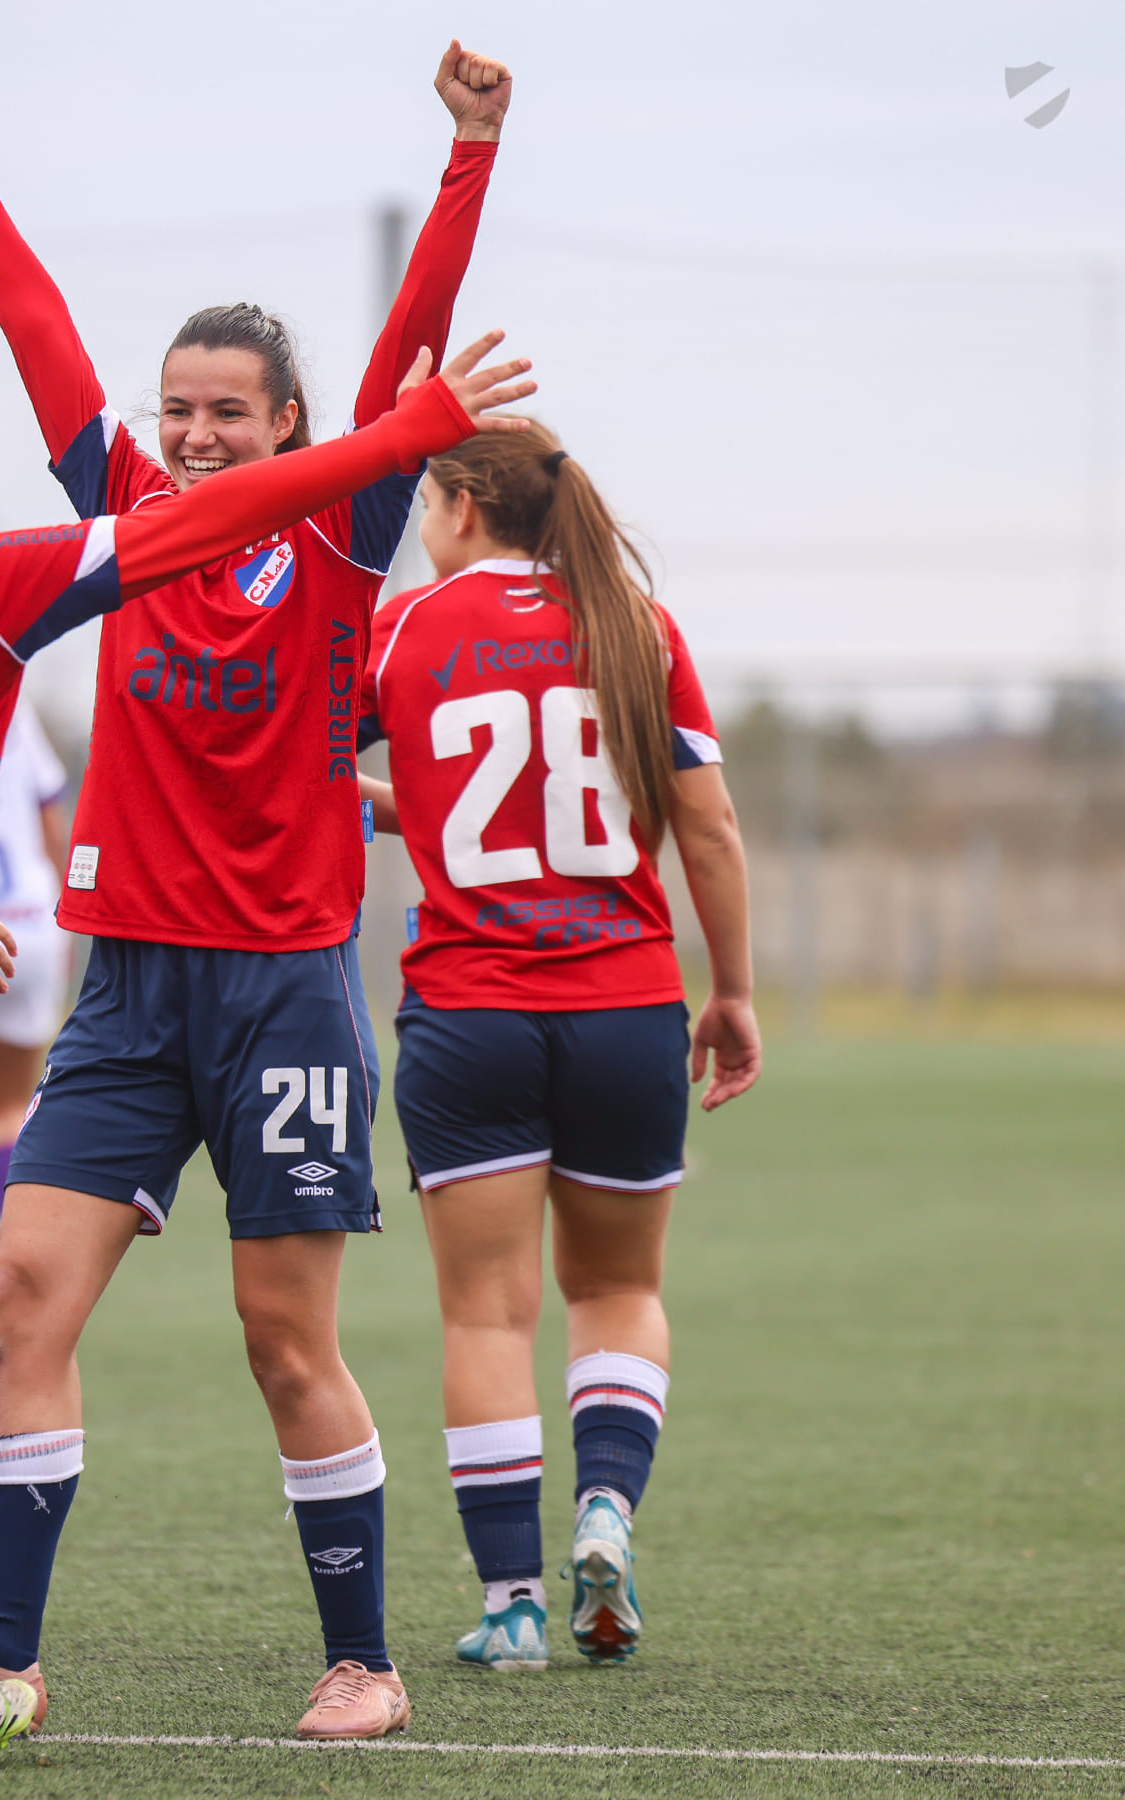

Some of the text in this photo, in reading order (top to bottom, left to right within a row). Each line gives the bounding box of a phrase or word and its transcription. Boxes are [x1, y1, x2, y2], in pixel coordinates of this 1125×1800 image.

[128, 632, 276, 714] antel
[328, 618, 356, 782] DIRECTV
[430, 686, 640, 889] 28
[477, 892, 629, 928] ASSIST
[534, 918, 642, 949] CARD
[261, 1066, 348, 1153] 24
[294, 1184, 334, 1197] umbro
[314, 1560, 364, 1575] umbro
